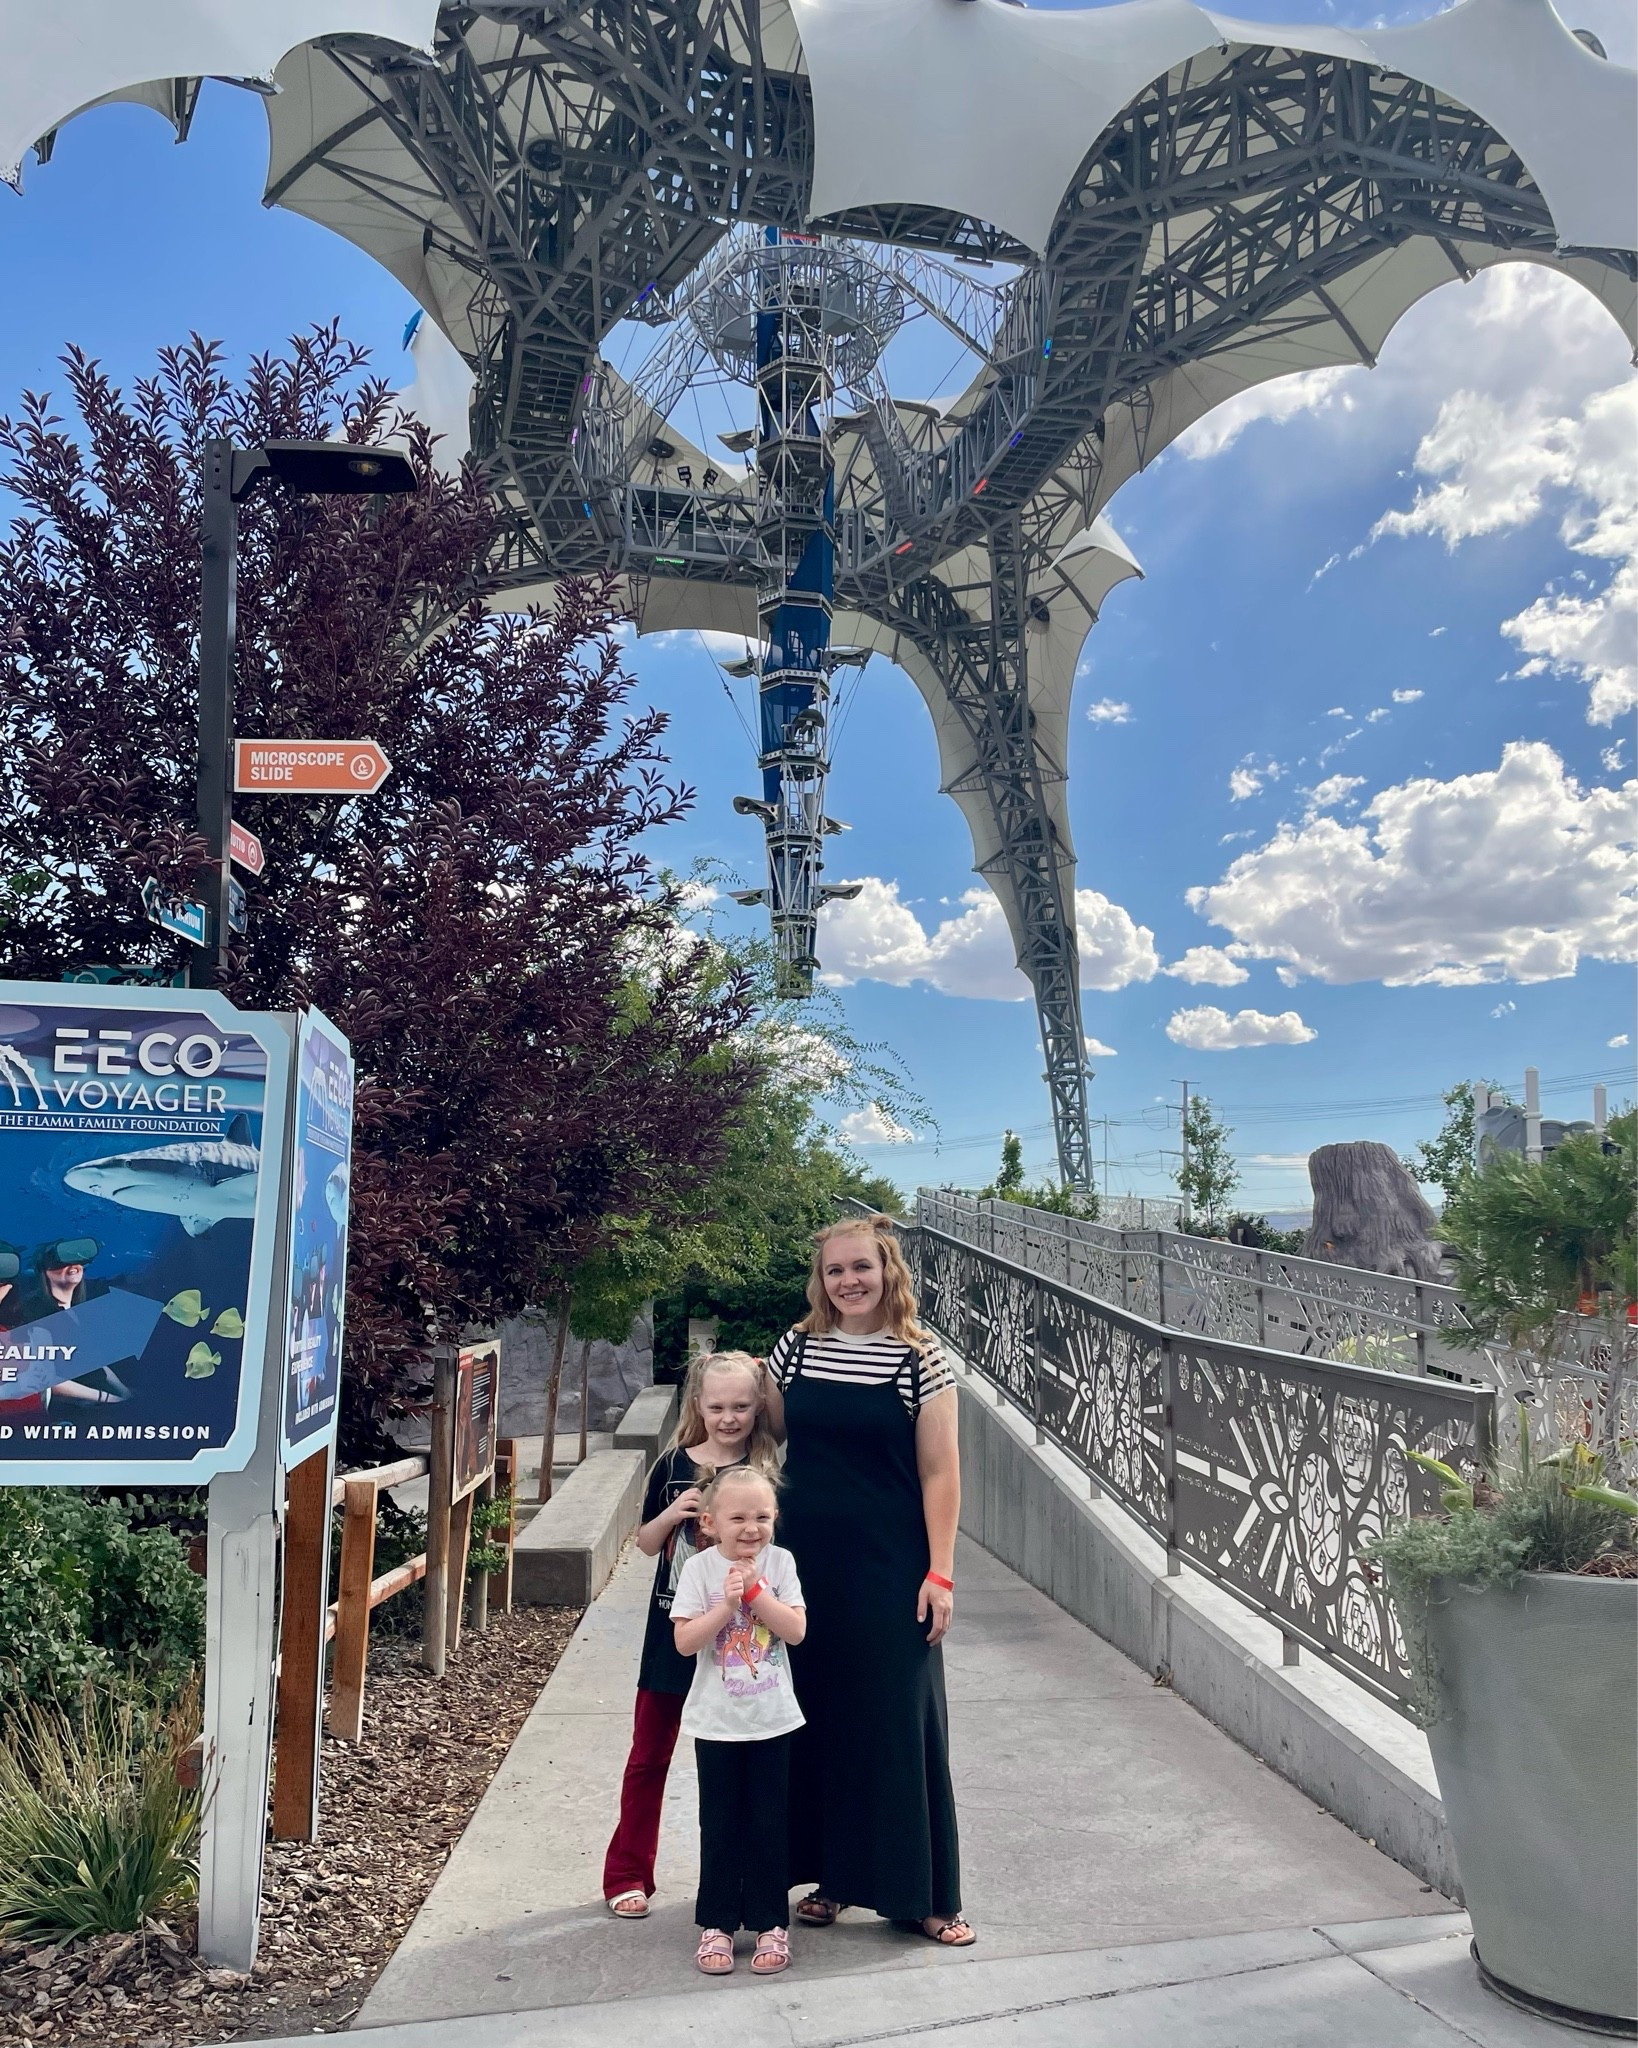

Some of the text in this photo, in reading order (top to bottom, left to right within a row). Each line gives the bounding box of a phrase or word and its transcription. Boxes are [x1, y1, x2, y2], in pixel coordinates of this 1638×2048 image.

[250, 751, 345, 766] MICROSCOPE
[250, 766, 294, 781] SLIDE
[53, 1027, 224, 1078] EECO
[53, 1079, 227, 1114] VOYAGER
[0, 1114, 221, 1132] THE FLAMM FAMILY FOUNDATION
[23, 1425, 77, 1440] WITH
[86, 1425, 211, 1440] ADMISSION
[658, 1598, 673, 1610] HON
